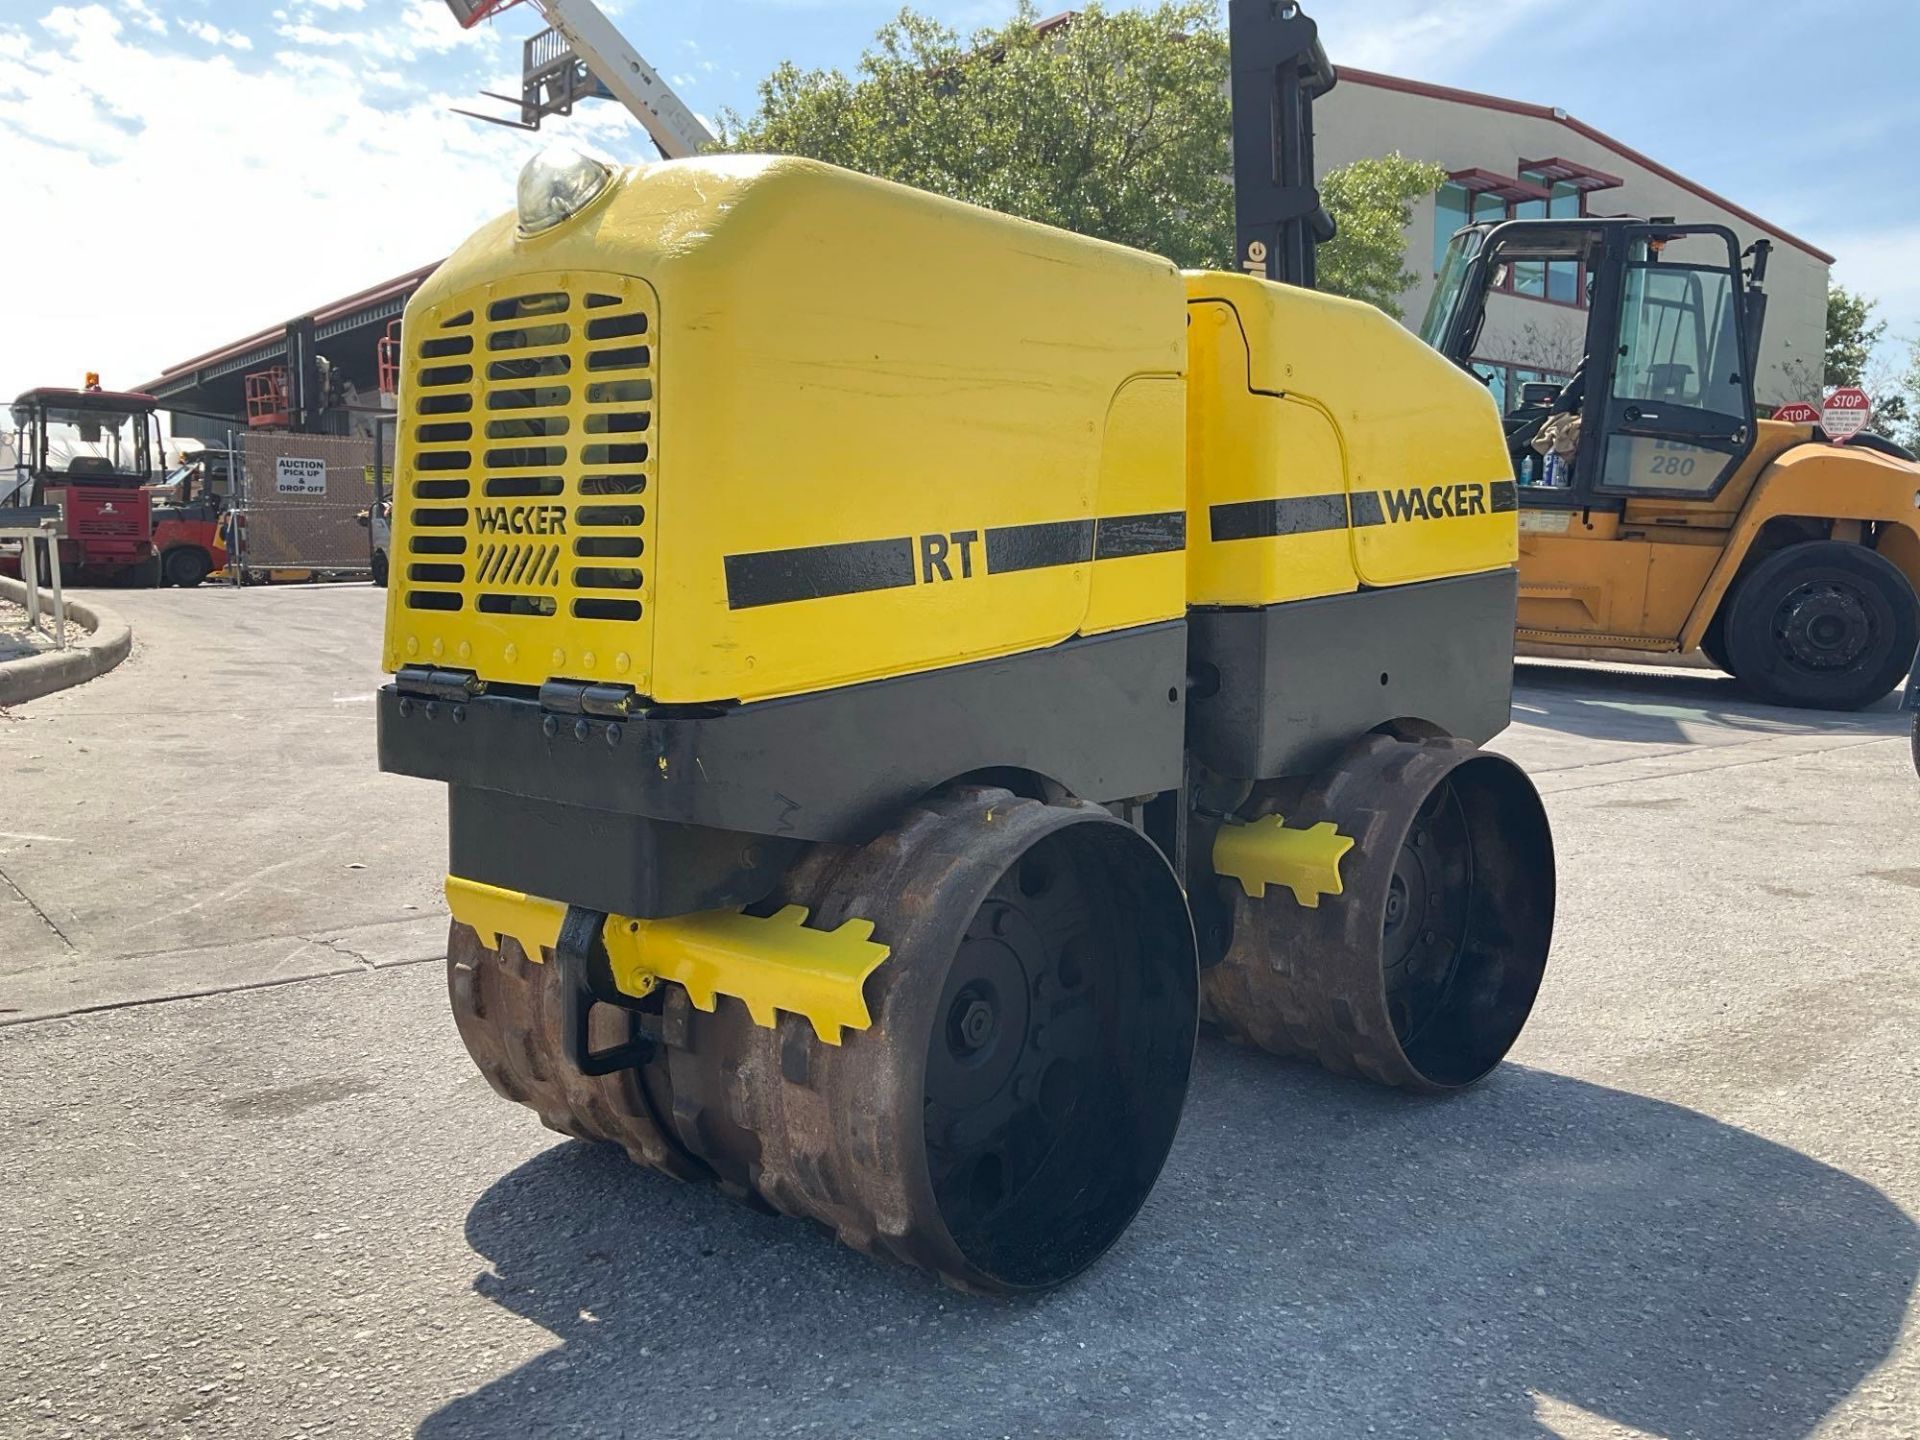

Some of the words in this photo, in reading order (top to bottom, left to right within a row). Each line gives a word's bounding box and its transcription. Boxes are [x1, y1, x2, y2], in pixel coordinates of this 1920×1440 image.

[1833, 395, 1862, 408] STOP
[1782, 409, 1811, 421] STOP
[279, 460, 324, 469] AUCTION
[1650, 455, 1695, 476] 280
[279, 484, 305, 492] DROP
[1383, 483, 1487, 523] WACKER
[474, 505, 567, 535] WACKER
[920, 530, 978, 584] RT
